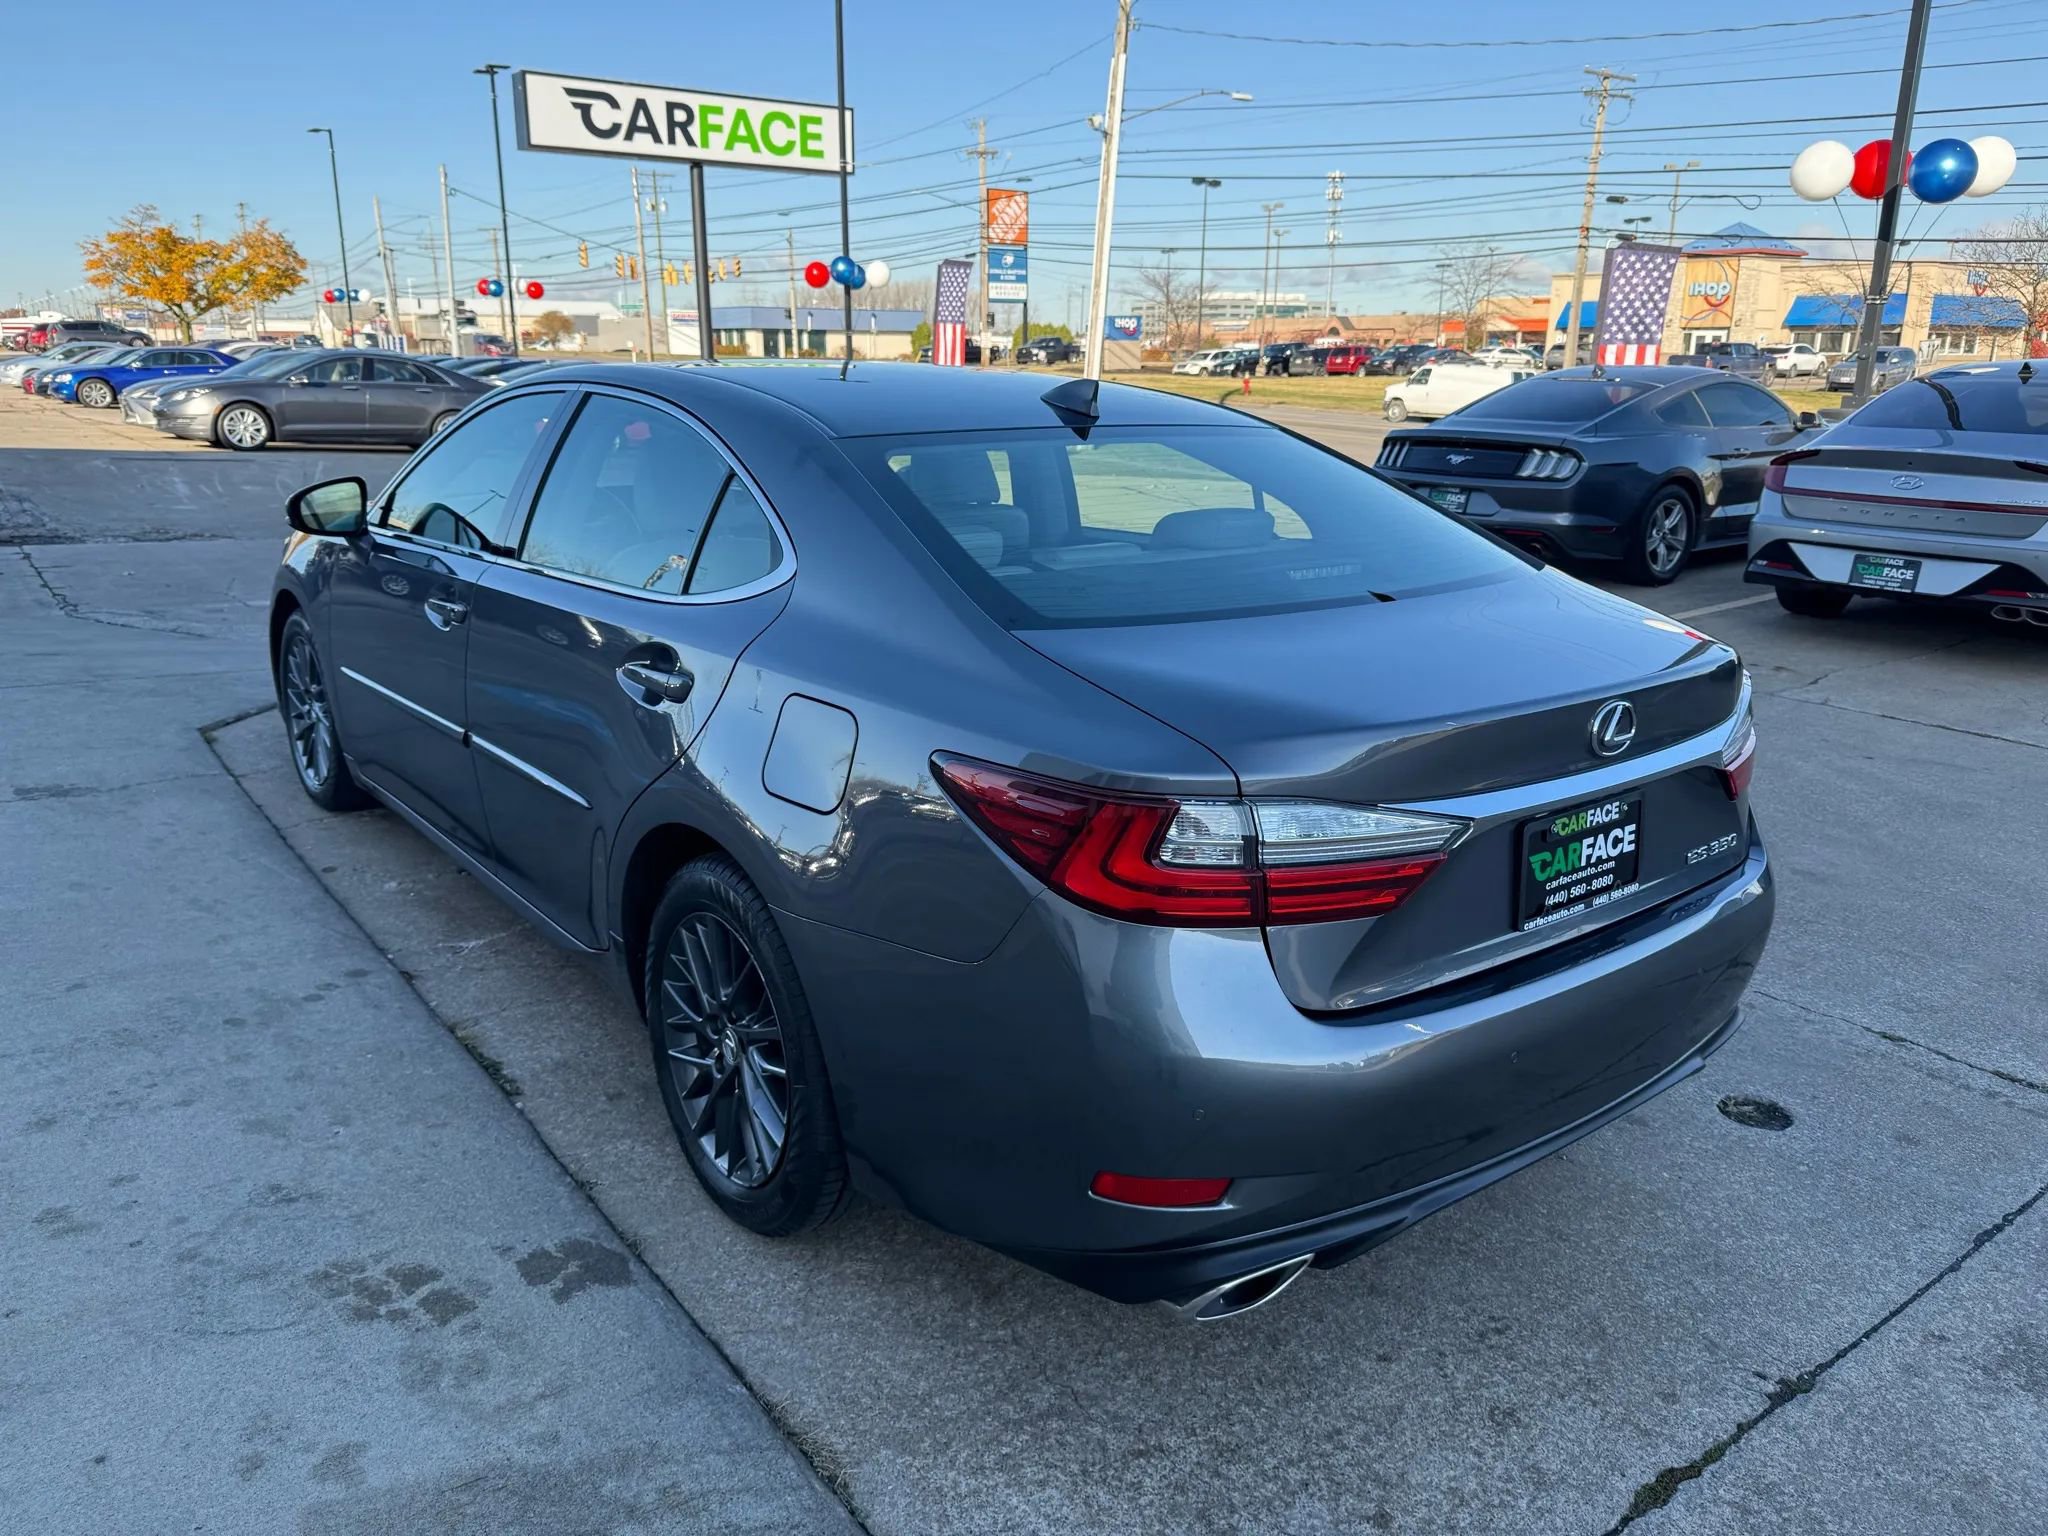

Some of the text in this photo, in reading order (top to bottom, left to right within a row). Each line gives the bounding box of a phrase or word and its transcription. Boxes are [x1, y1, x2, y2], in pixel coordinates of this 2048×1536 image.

[562, 87, 824, 159] CARFACE
[1838, 505, 1967, 522] SONATA
[1856, 564, 1914, 580] CARFACE
[1555, 801, 1620, 836] CARFACE
[1529, 824, 1636, 881] CARFACE
[1545, 861, 1616, 890] carfaceauto.com
[1523, 903, 1585, 931] carfaceauto.com
[1592, 893, 1609, 908] (440)
[1545, 889, 1568, 906] (440)
